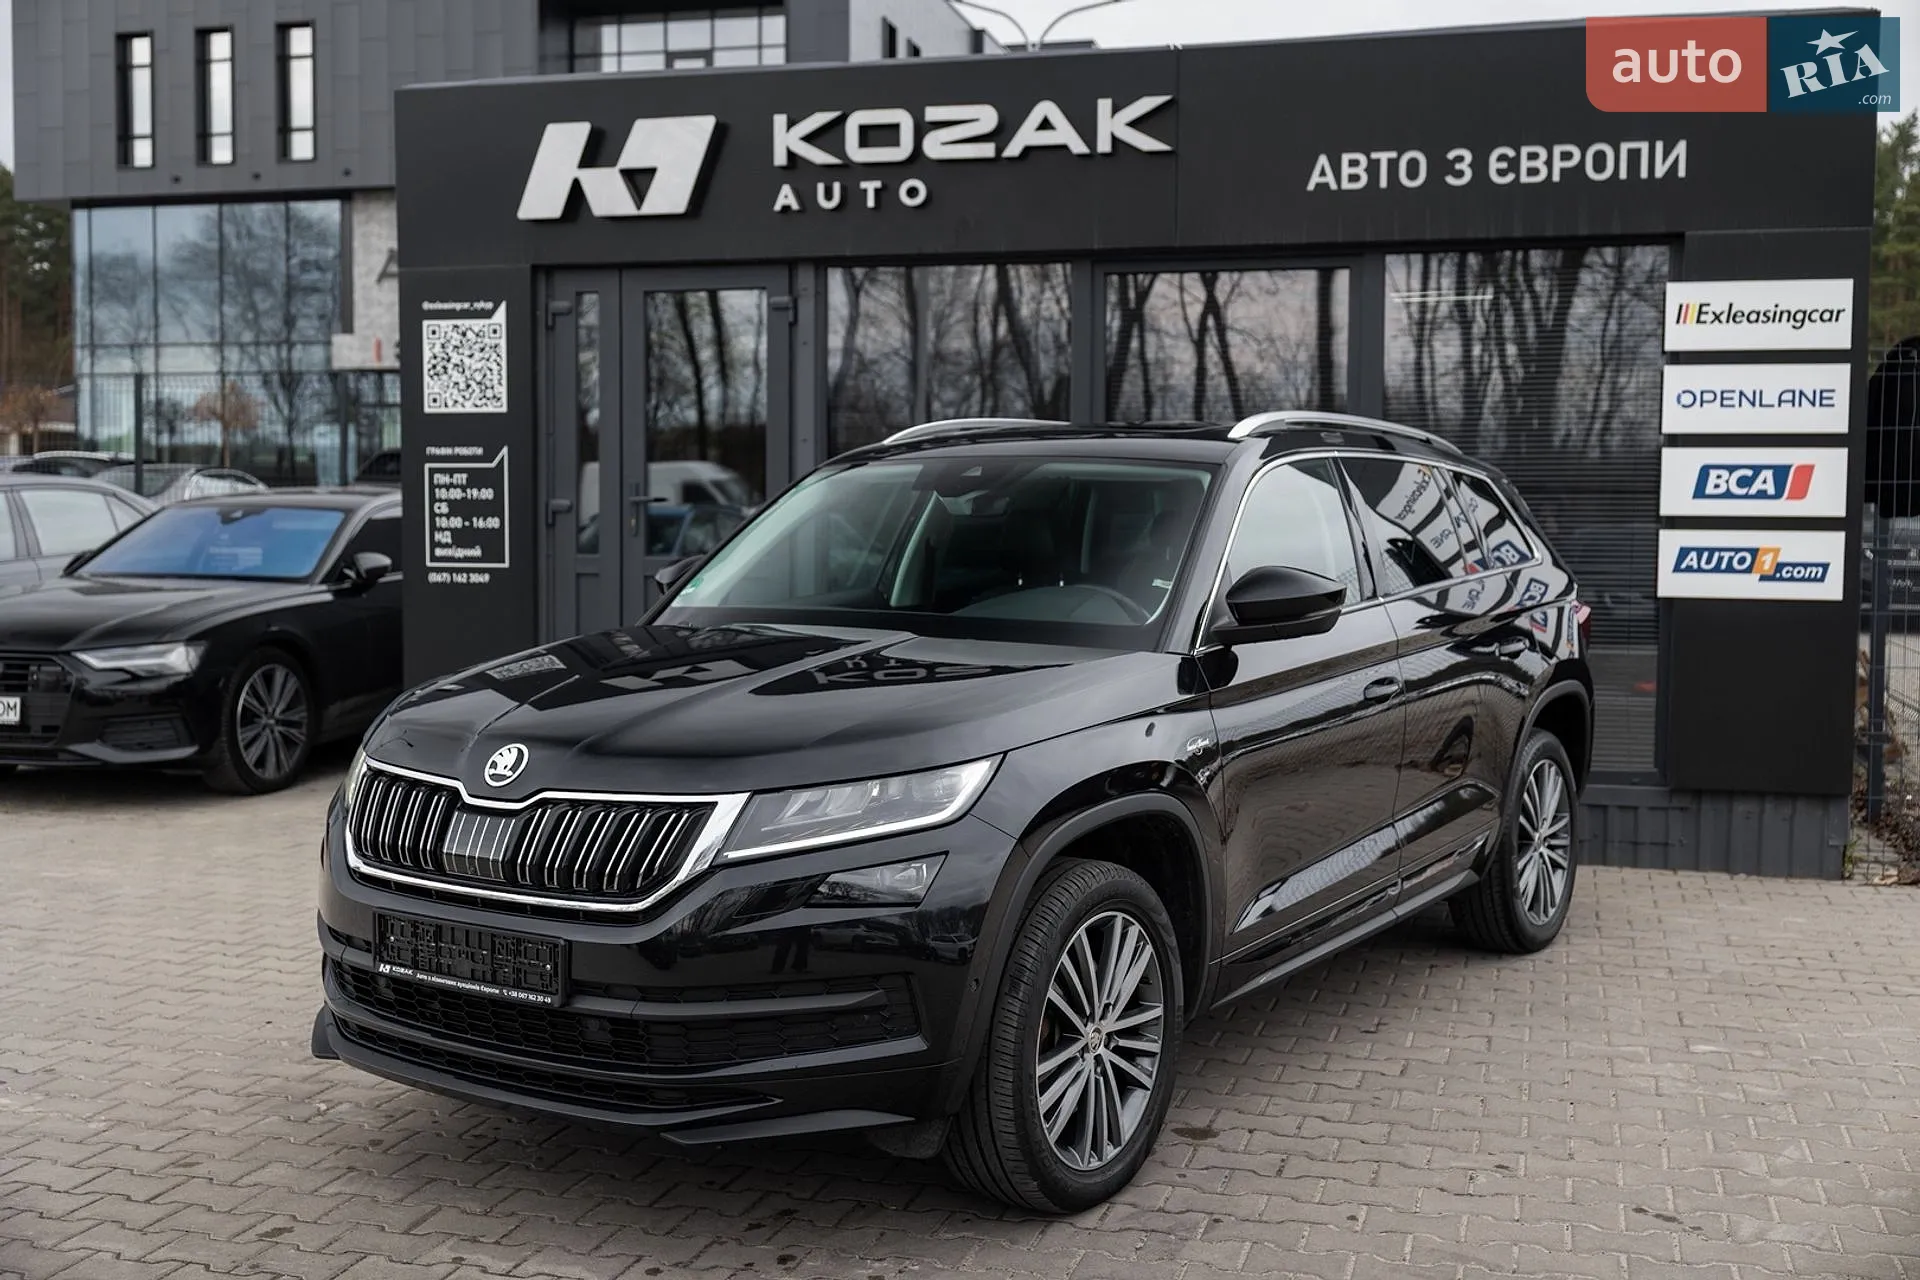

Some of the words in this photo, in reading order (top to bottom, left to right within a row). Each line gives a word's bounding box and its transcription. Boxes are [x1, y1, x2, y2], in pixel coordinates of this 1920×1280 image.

[772, 94, 1175, 168] KOZAK
[1306, 150, 1428, 191] АВТО
[1444, 147, 1474, 187] З
[1488, 139, 1688, 185] ЄВРОПИ
[772, 177, 930, 213] AUTO
[1696, 302, 1846, 330] Exleasingcar
[1676, 389, 1836, 408] OPENLANE
[433, 473, 468, 485] ПН-ПТ
[1705, 468, 1776, 496] BCA
[433, 502, 449, 515] СБ
[1680, 551, 1823, 579] AUTO1.com
